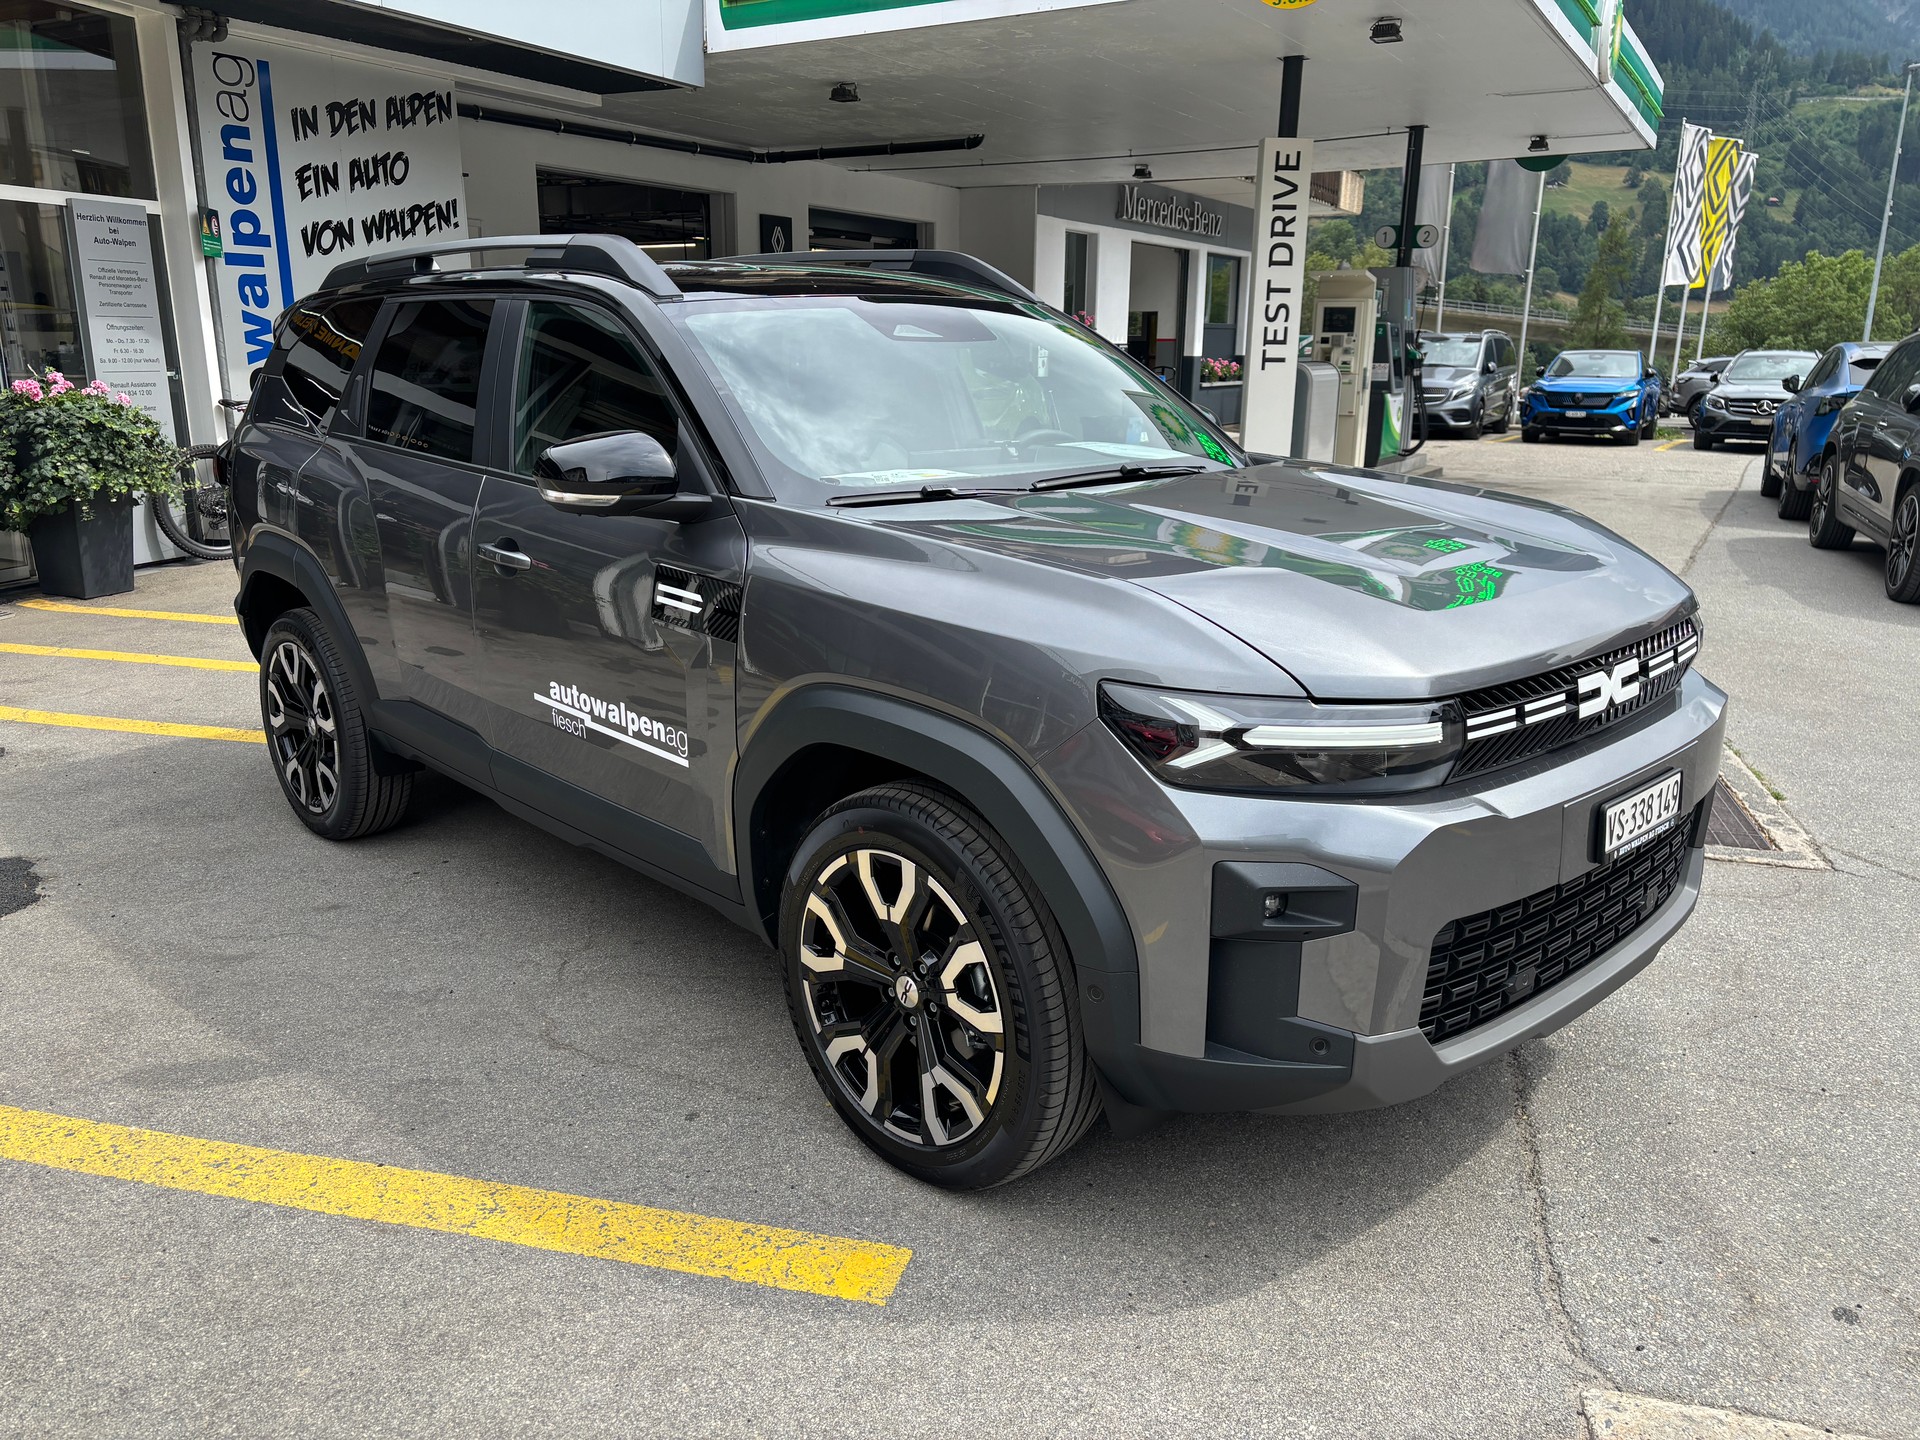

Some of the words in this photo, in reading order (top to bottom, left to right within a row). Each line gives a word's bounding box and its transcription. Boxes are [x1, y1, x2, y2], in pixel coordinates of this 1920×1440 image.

[290, 105, 319, 143] IN
[325, 98, 376, 138] DEN
[385, 90, 453, 132] ALPEN
[294, 161, 340, 203] EIN
[349, 151, 410, 194] AUTO
[76, 212, 105, 223] Herzlich
[106, 215, 147, 226] Willkommen
[108, 227, 120, 235] bei
[300, 216, 355, 259] VON
[361, 198, 460, 247] WALPEN!
[1121, 184, 1223, 237] Mercedes-Benz
[1268, 150, 1301, 268] DRIVE
[93, 236, 137, 248] Auto-Walpen
[1382, 231, 1388, 243] 1
[1422, 230, 1431, 243] 2
[1261, 279, 1291, 371] TEST
[549, 681, 689, 757] autowalpenag
[551, 708, 587, 739] fiesch
[1656, 779, 1679, 820] 149
[981, 913, 1031, 1055] MICHELIN
